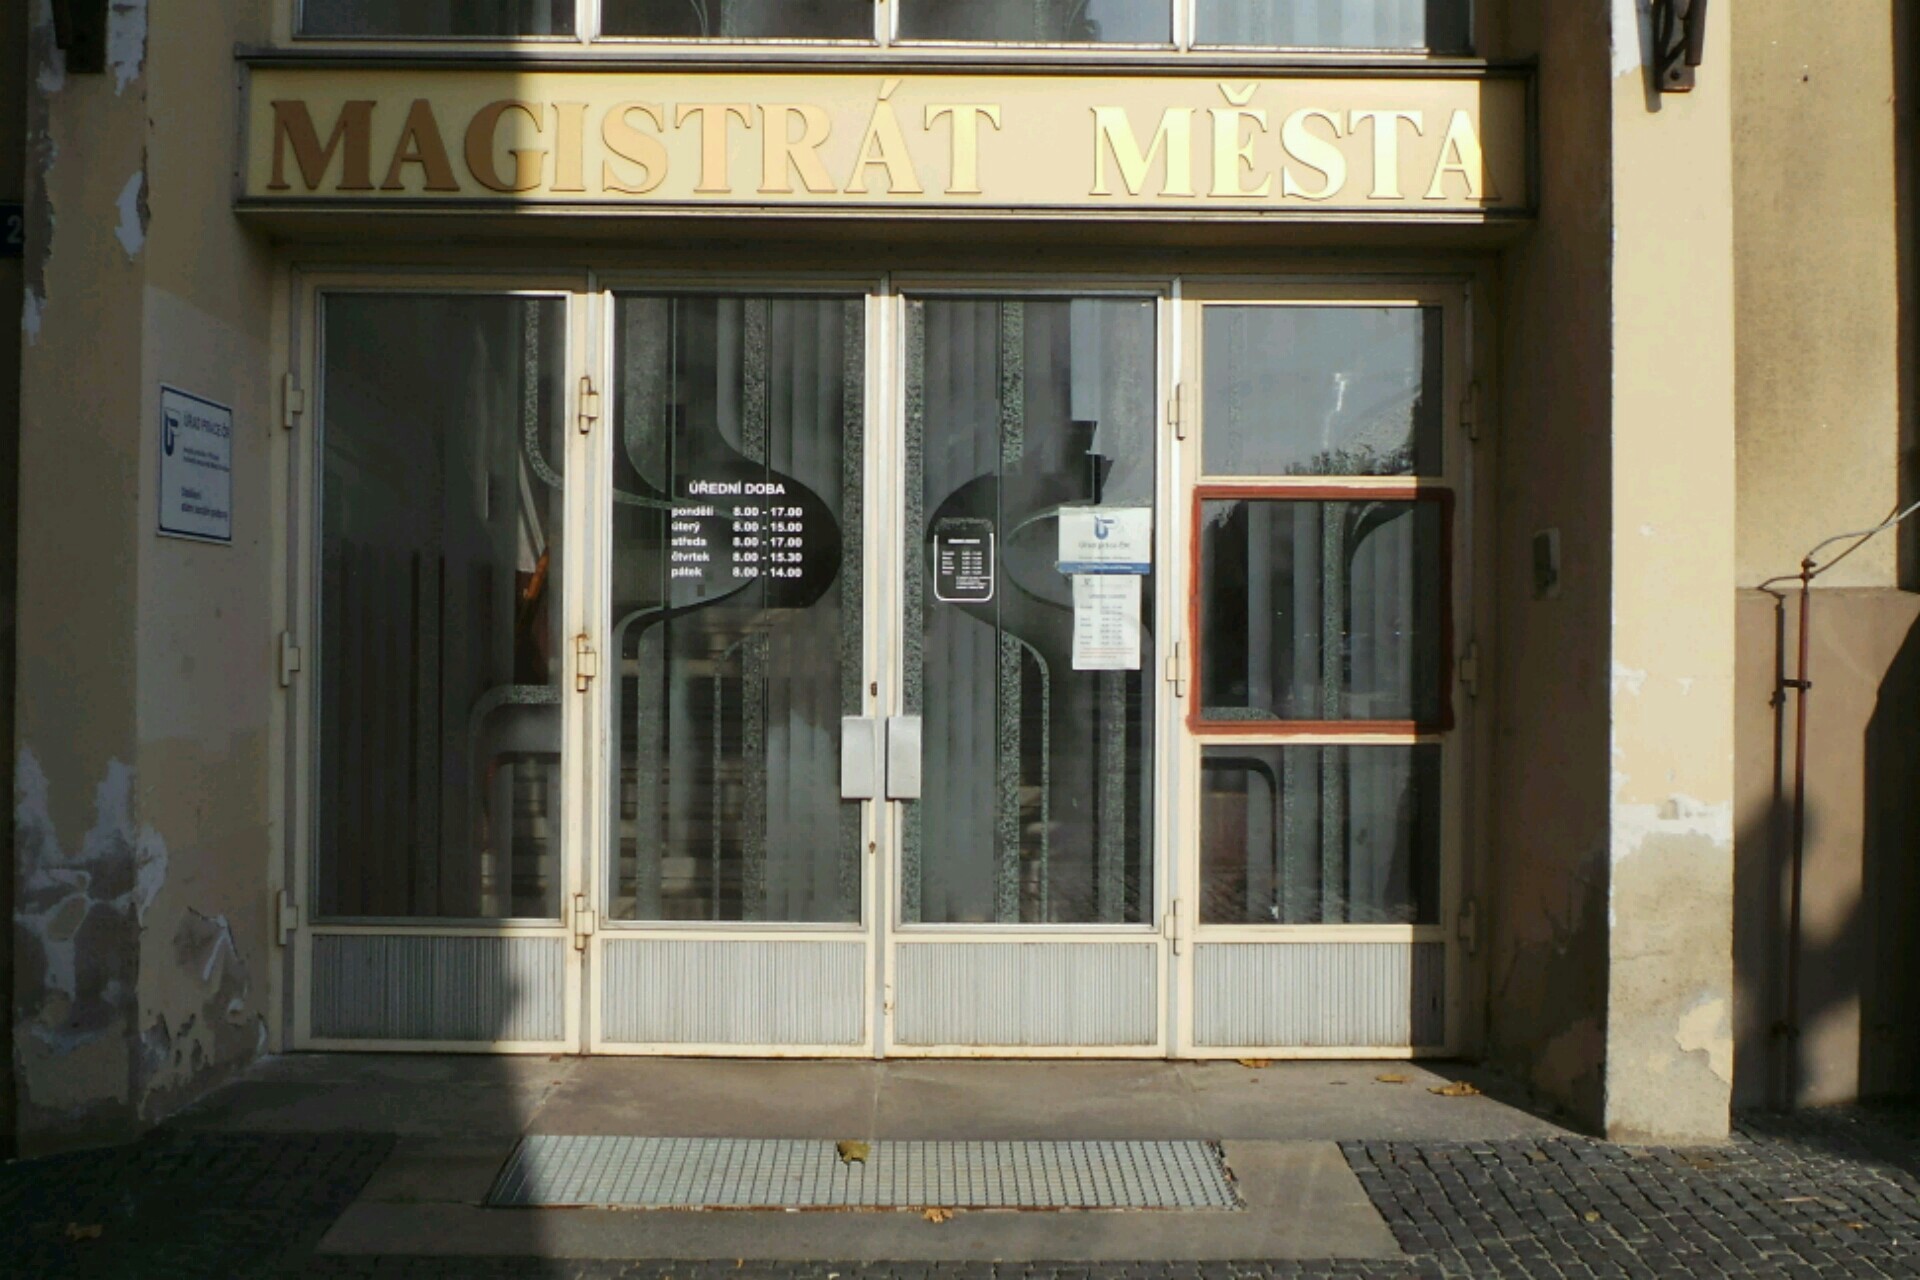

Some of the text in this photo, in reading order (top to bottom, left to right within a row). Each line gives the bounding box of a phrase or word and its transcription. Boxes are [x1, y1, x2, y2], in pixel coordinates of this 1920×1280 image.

[266, 78, 1502, 201] MAGISTRÁT MĚSTA
[689, 480, 786, 495] ÚŘEDNÍ DOBA
[671, 506, 714, 518] pondělí
[732, 507, 759, 517] 8.00
[770, 507, 803, 517] 17.00
[671, 521, 700, 533] úterý
[732, 522, 759, 532] 8.00
[770, 522, 803, 532] 15.00
[671, 536, 707, 547] středa
[732, 537, 759, 547] 8.00
[770, 537, 803, 547] 17.00
[671, 552, 710, 562] čtvrtek
[732, 552, 759, 562] 8.00
[770, 552, 803, 562] 15.30
[671, 567, 702, 578] pátek
[732, 568, 759, 577] 8.00
[770, 568, 803, 577] 14.00
